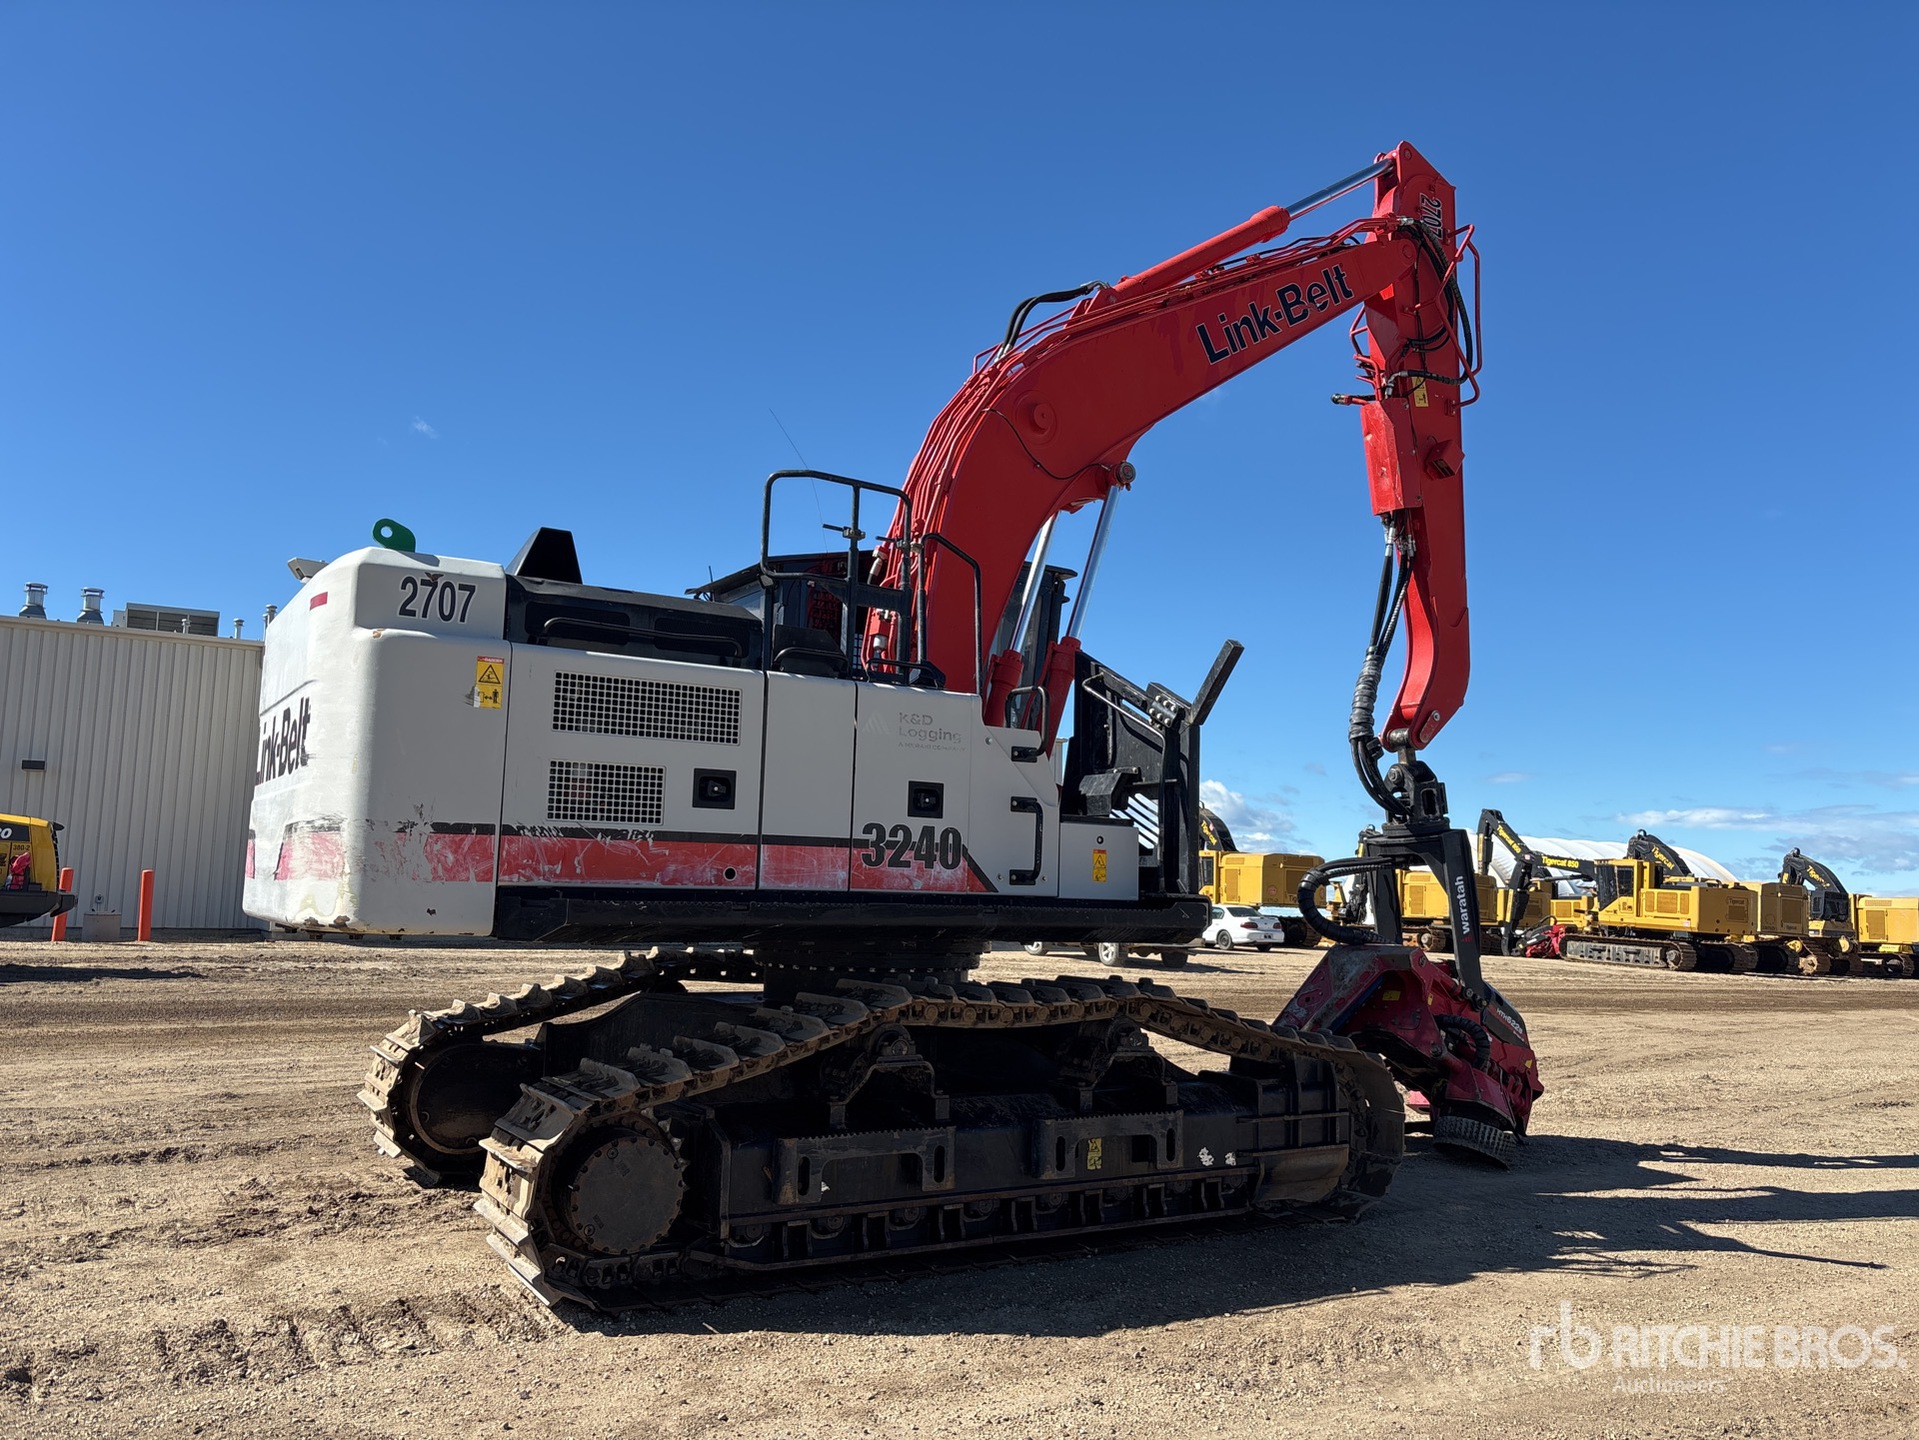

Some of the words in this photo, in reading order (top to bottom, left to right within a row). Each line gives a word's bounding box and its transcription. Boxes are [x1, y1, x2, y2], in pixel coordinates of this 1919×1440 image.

[1419, 192, 1443, 240] 2707
[1196, 264, 1354, 365] Link-Belt
[398, 575, 477, 623] 2707
[899, 712, 933, 726] K&D
[899, 726, 962, 743] Logging
[861, 822, 962, 870] 3240
[1497, 824, 1515, 846] Tigercat
[1542, 855, 1567, 867] Tigercat
[1567, 859, 1579, 868] 850
[1651, 845, 1675, 870] Tigercat
[1454, 875, 1470, 935] waratah
